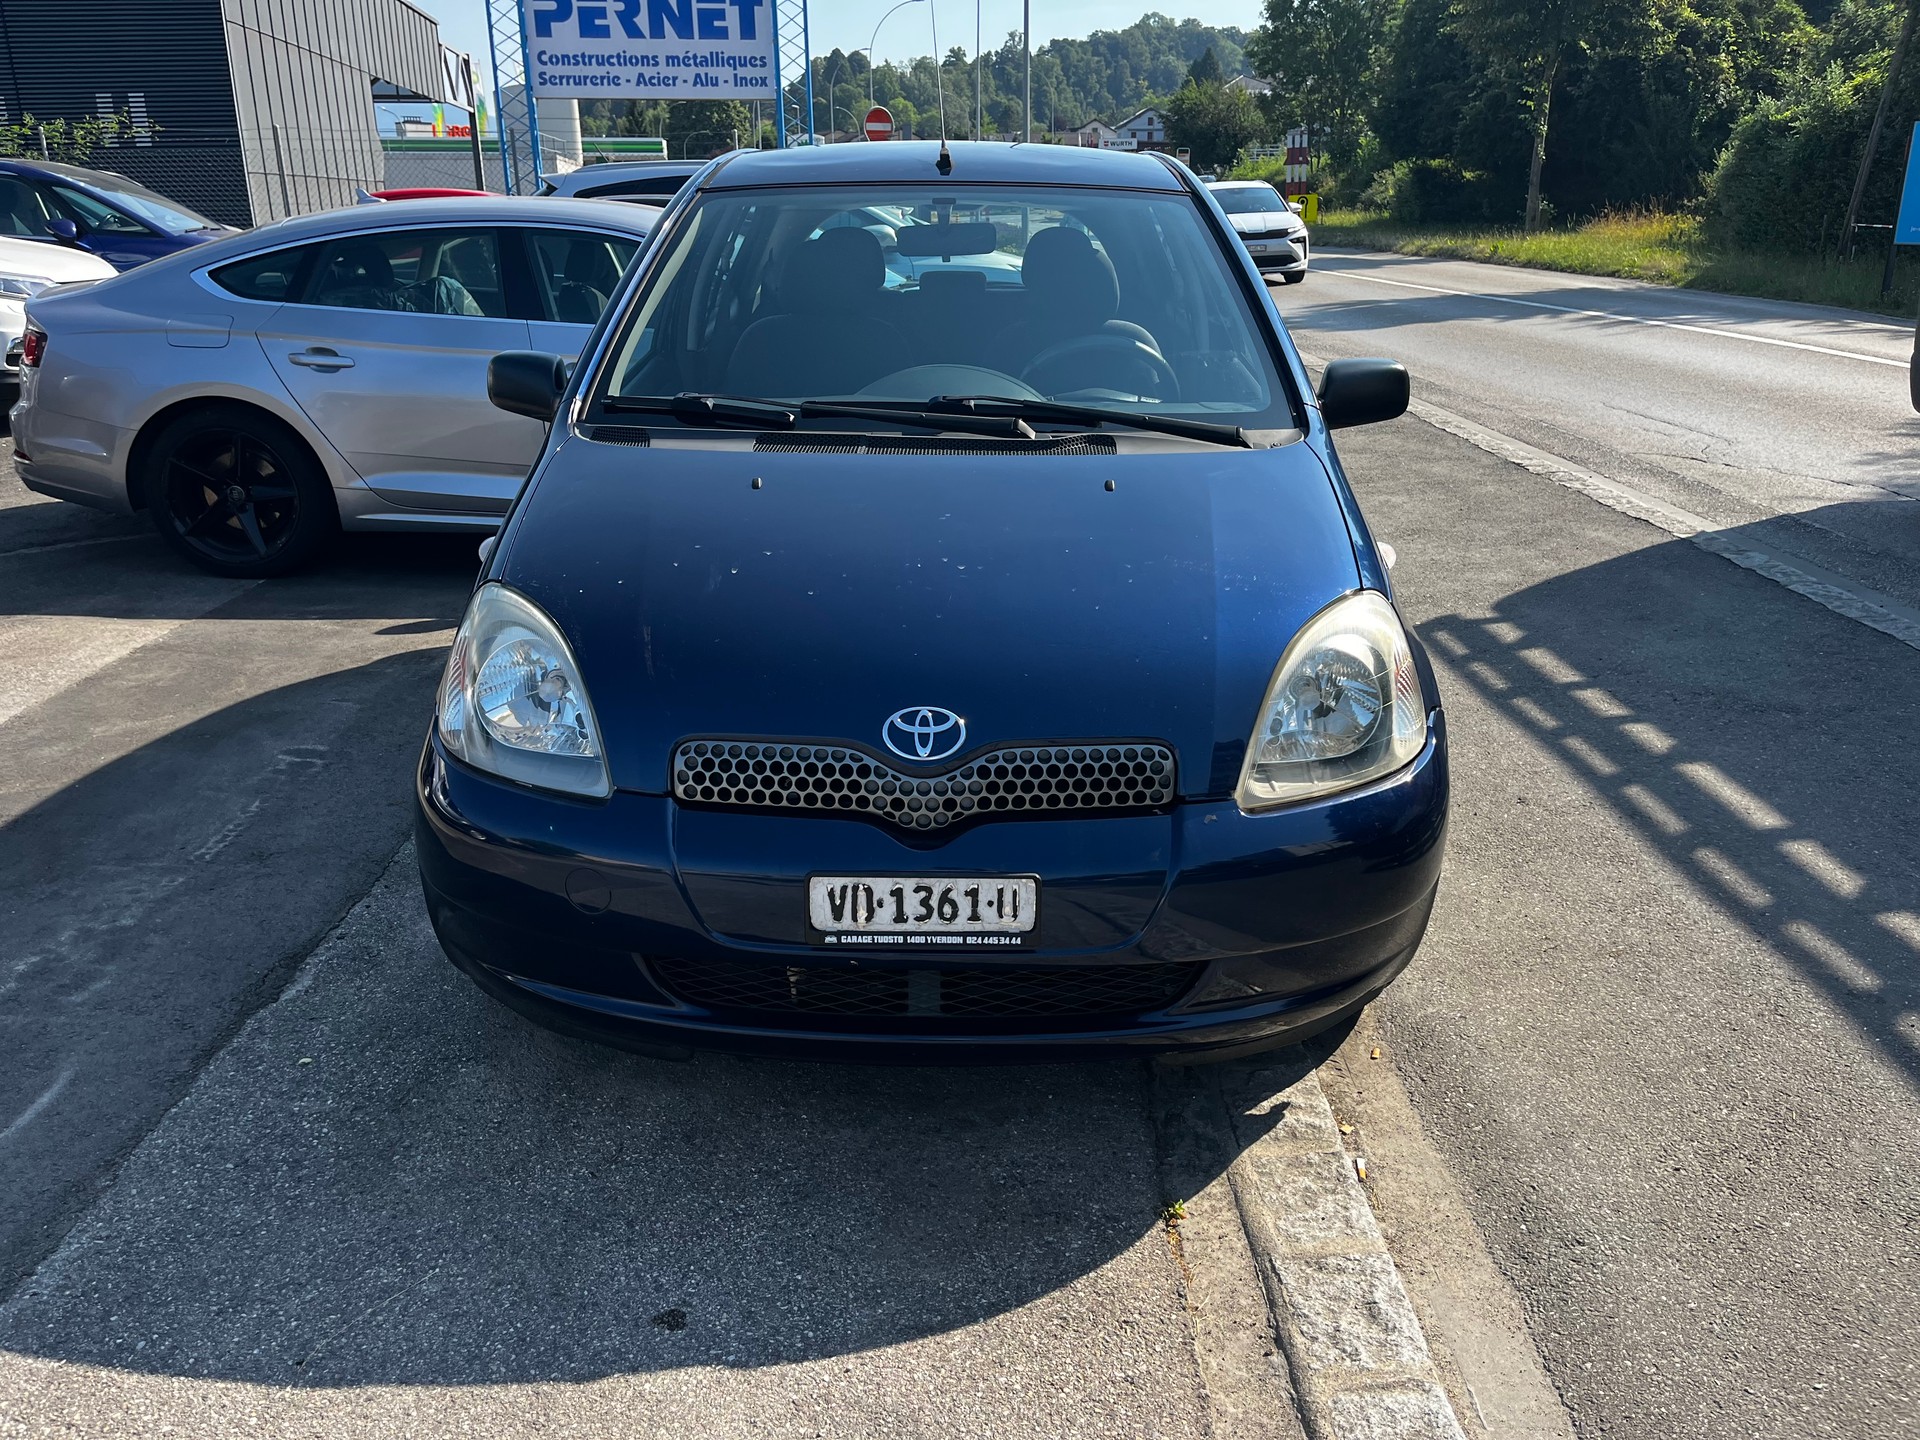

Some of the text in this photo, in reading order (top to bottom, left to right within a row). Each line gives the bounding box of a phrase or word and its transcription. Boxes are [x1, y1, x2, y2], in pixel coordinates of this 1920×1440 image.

[533, 0, 763, 40] PERNET
[537, 50, 768, 71] Constructions métalliques
[538, 71, 621, 86] Serrurerie
[635, 71, 678, 87] Acier
[692, 72, 719, 87] Alu
[733, 72, 768, 88] Inox
[841, 935, 873, 944] GARAGE
[873, 935, 904, 944] TUOSTO
[906, 935, 926, 944] 1400
[926, 935, 963, 944] YVERDON
